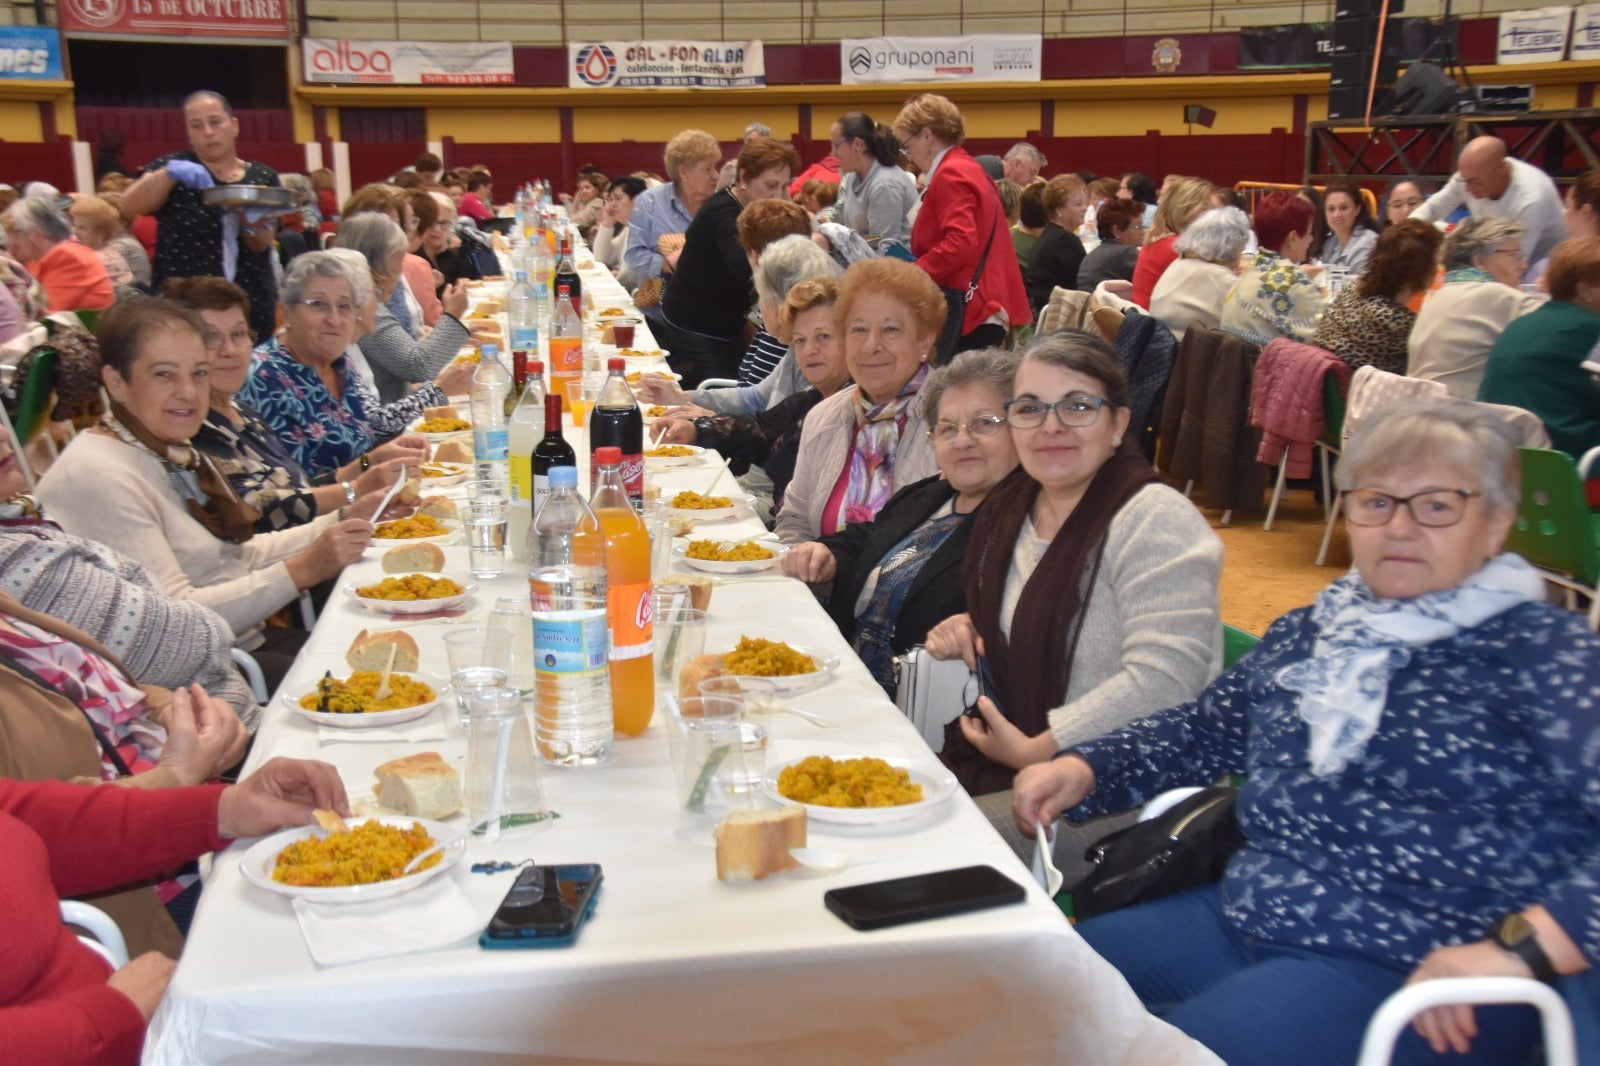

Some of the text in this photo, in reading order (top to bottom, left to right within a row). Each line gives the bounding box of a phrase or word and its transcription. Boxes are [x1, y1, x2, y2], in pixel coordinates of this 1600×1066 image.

[160, 0, 182, 16] DE
[185, 0, 283, 20] OCTUBRE
[313, 40, 391, 73] alba
[626, 47, 656, 62] CAL
[668, 46, 699, 62] FON
[703, 48, 744, 63] ALBA
[875, 45, 975, 70] gruponani
[627, 63, 675, 74] calefacción
[731, 66, 744, 77] gas
